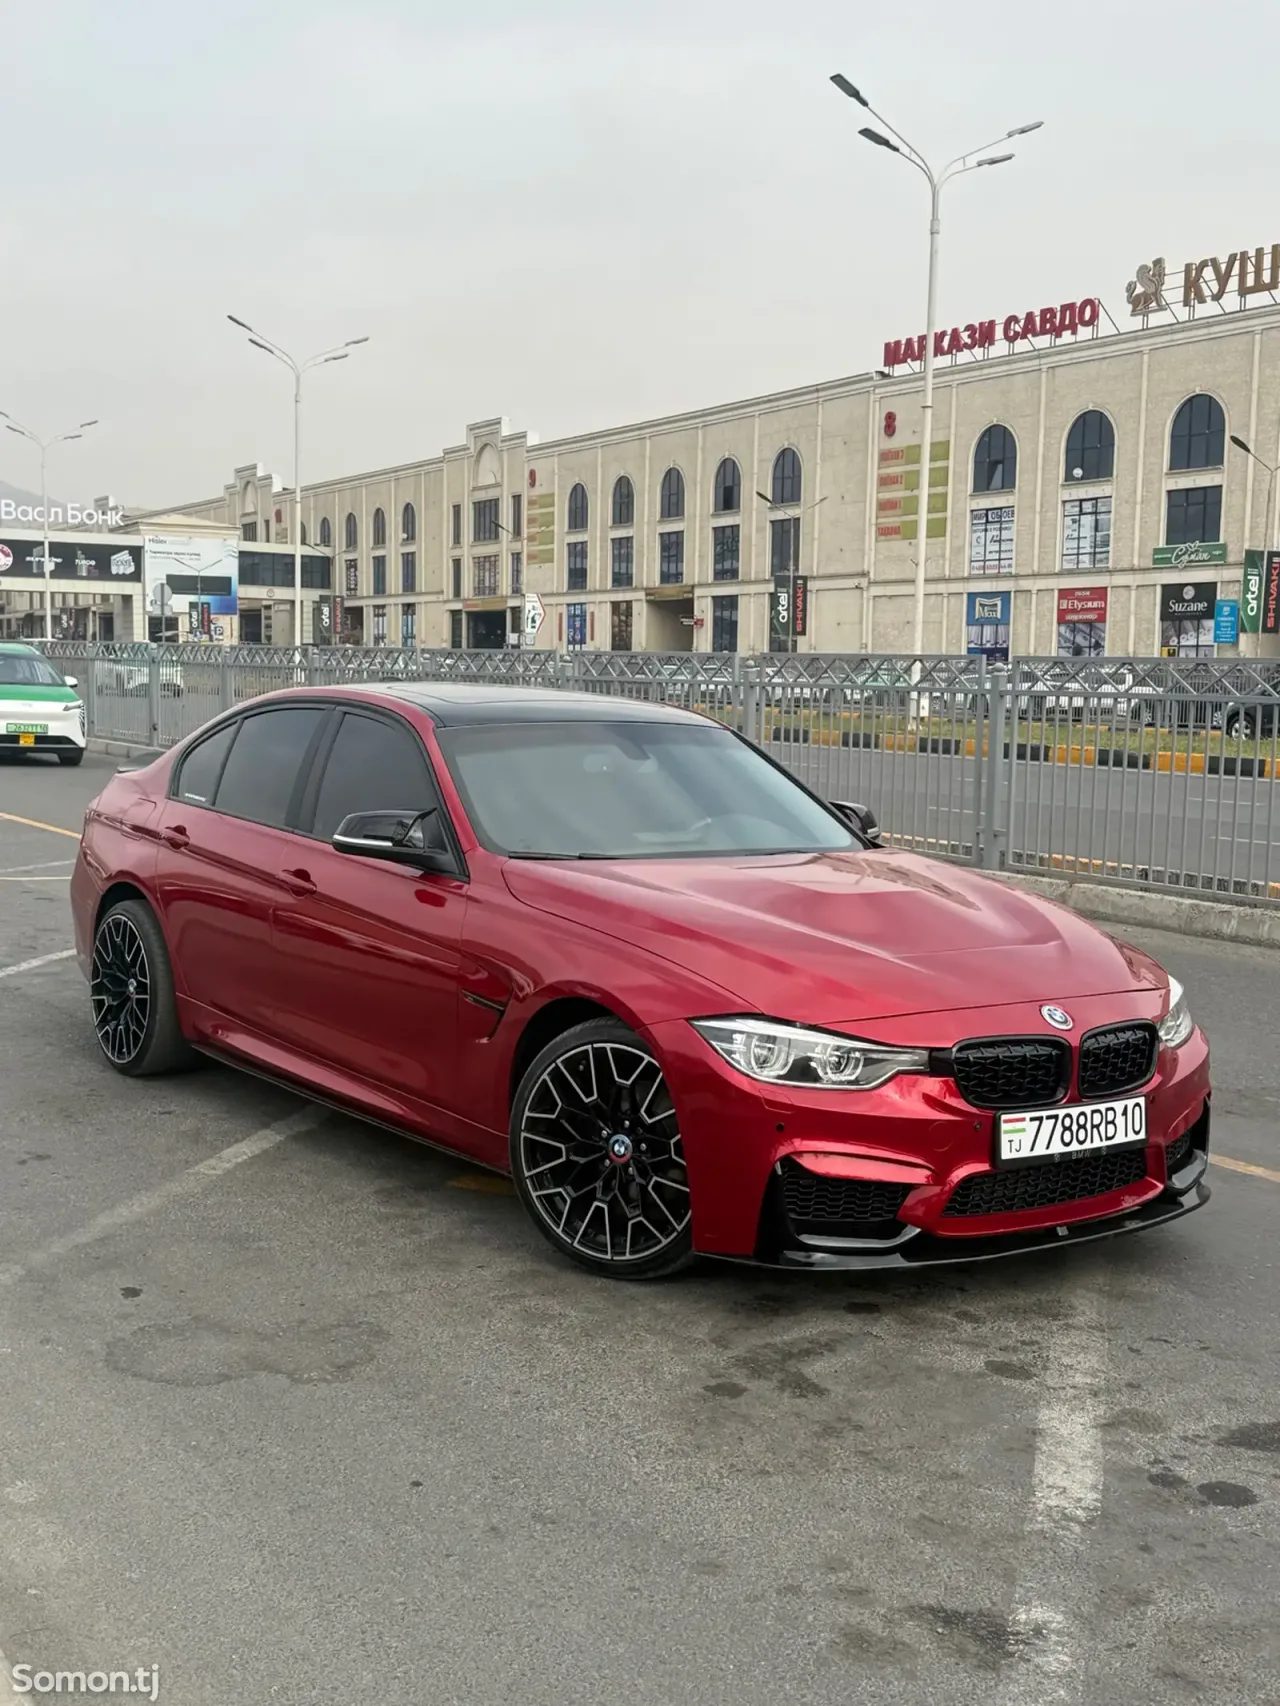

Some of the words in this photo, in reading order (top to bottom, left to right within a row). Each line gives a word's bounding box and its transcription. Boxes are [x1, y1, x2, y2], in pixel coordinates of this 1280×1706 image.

[883, 319, 996, 367] МАРКАЗИ
[1003, 298, 1100, 343] САВДО
[883, 411, 896, 438] 8
[0, 499, 63, 523] Васл
[67, 503, 125, 526] Бонк
[777, 593, 788, 623] artel
[796, 584, 804, 632] SHIVAKI
[1068, 599, 1105, 611] Elysium
[1168, 599, 1208, 612] Suzane
[1246, 575, 1260, 616] artel
[1267, 563, 1280, 628] SHIVAKI
[1029, 1102, 1143, 1152] 7788RB10
[1008, 1139, 1022, 1153] TJ
[1071, 1149, 1092, 1160] BMW
